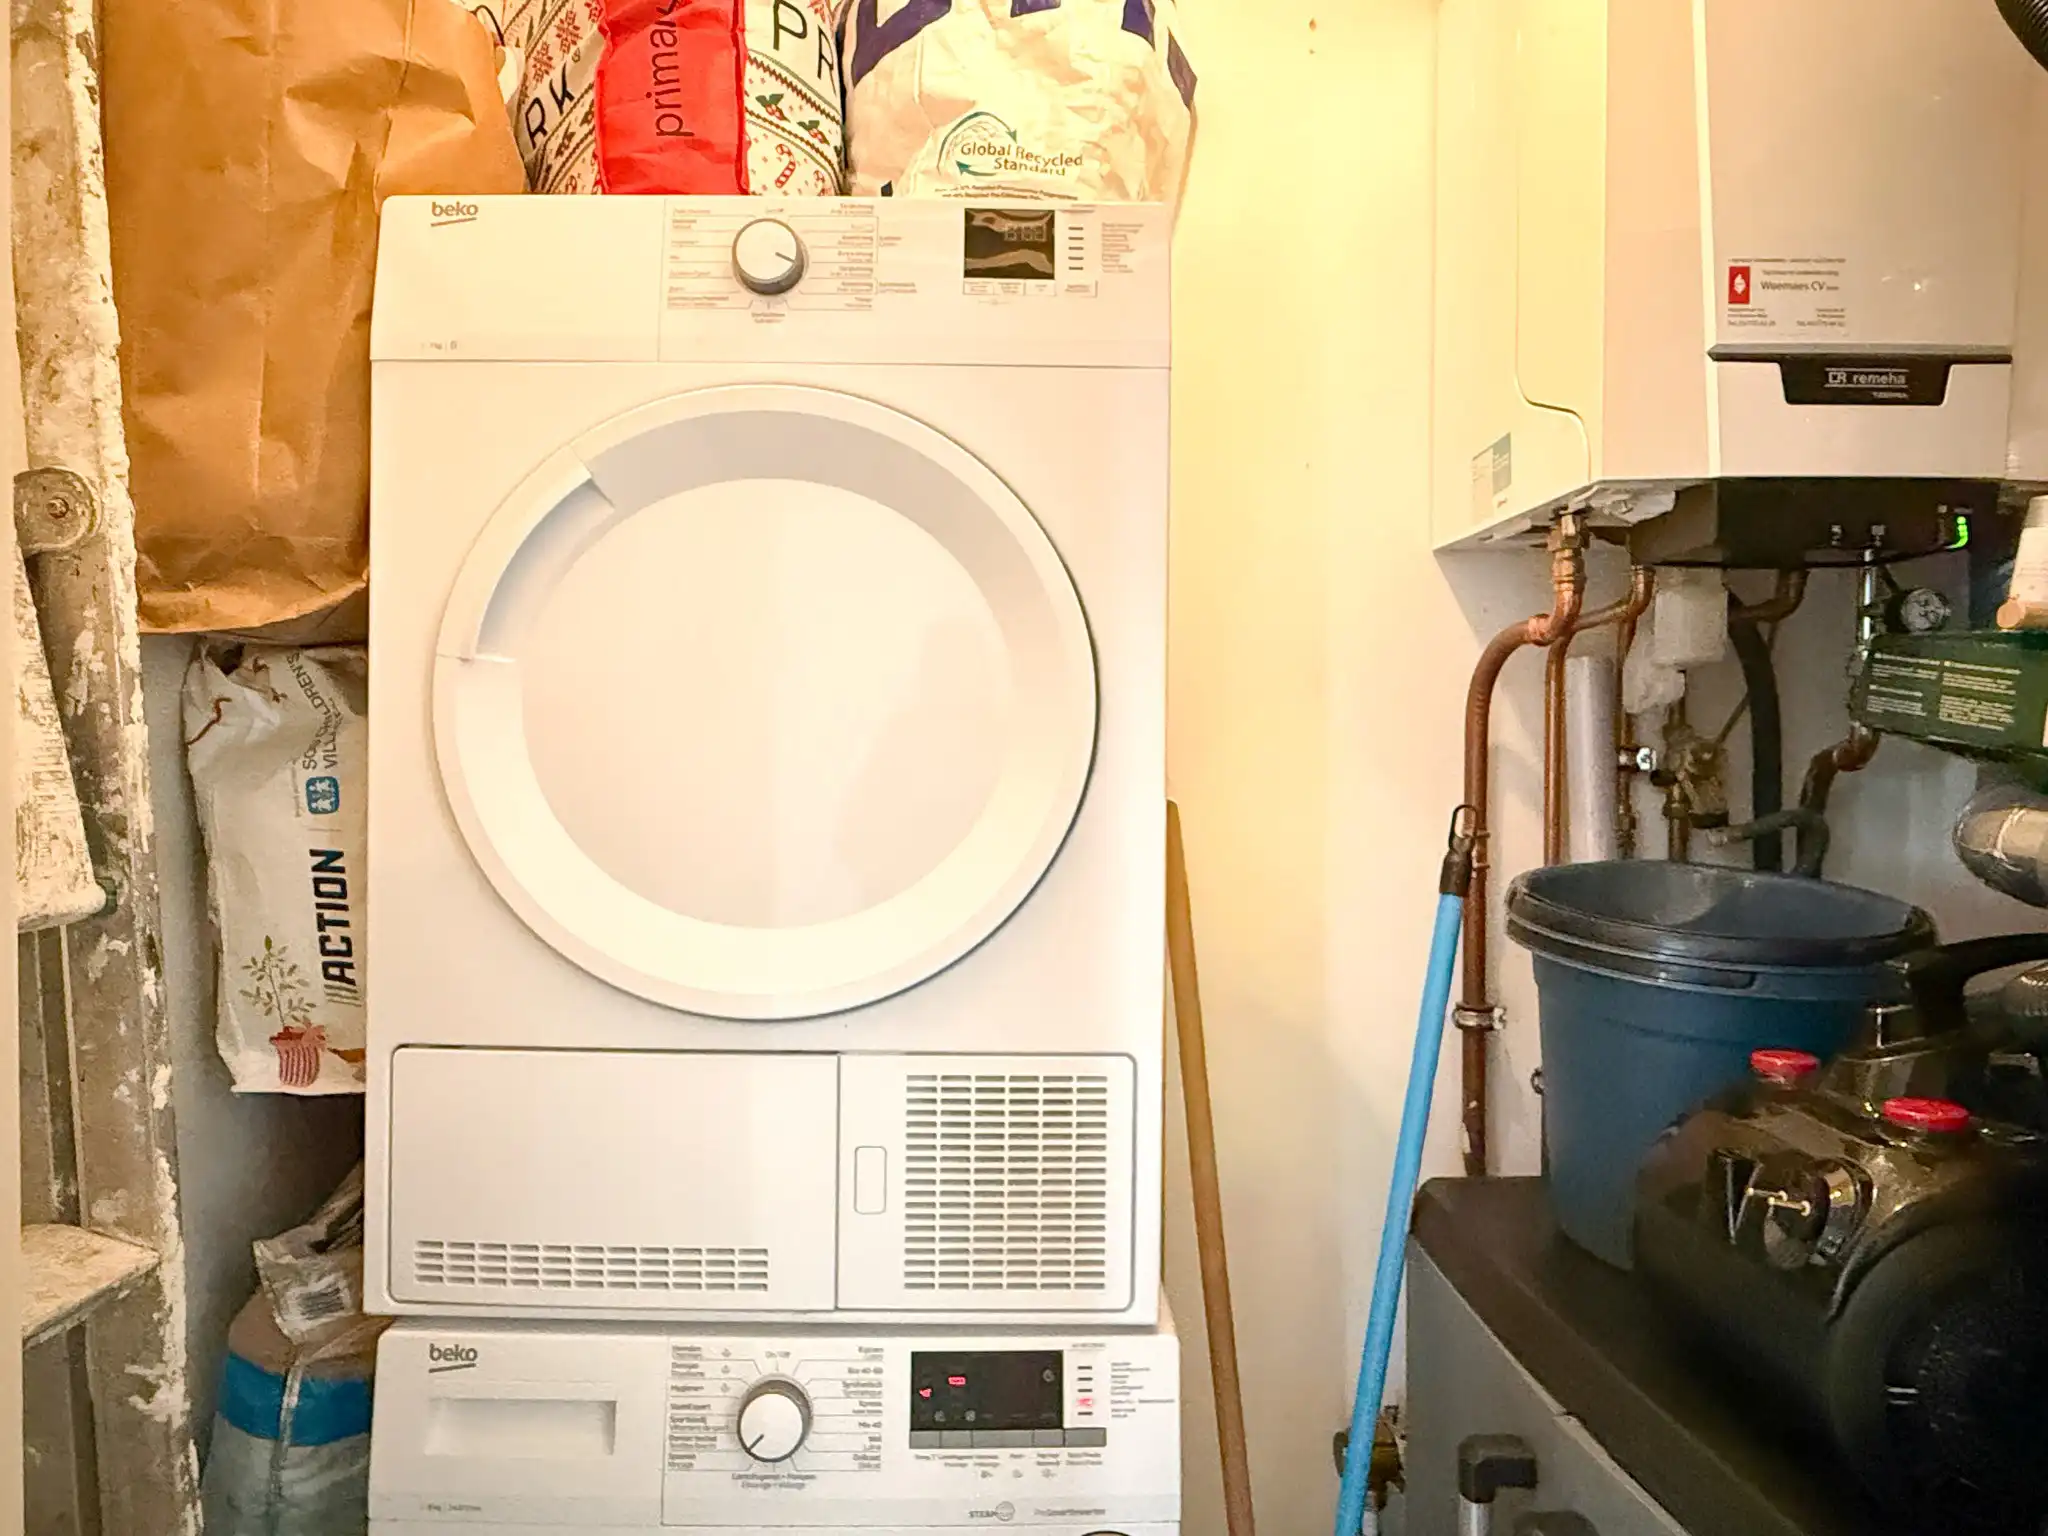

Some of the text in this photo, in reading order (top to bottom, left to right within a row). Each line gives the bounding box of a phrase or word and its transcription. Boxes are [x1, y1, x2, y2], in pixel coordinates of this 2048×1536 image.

[960, 141, 1084, 168] Global Recycled
[993, 157, 1067, 177] Standard
[431, 201, 479, 217] beko
[1852, 371, 1906, 385] remeha
[309, 848, 357, 987] ACTION
[429, 1342, 478, 1362] beko
